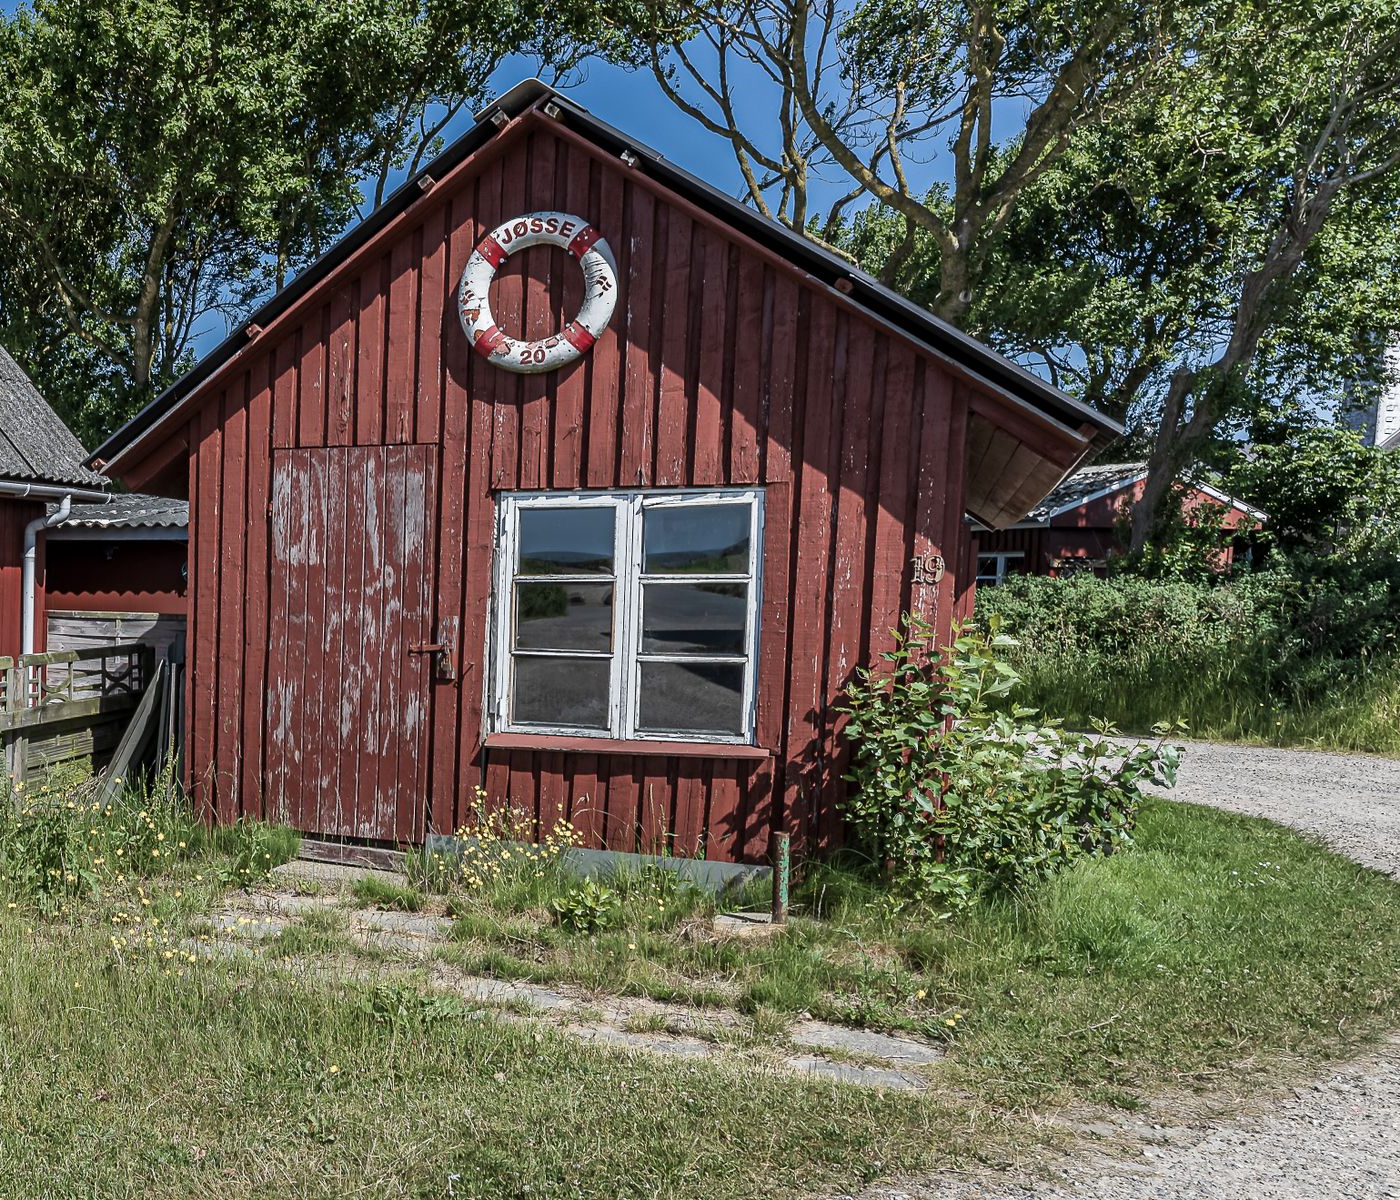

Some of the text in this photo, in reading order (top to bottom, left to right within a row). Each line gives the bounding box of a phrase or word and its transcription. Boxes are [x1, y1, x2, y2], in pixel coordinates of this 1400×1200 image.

[501, 218, 576, 244] JØSSE
[520, 350, 545, 364] 20
[910, 555, 946, 584] 19
